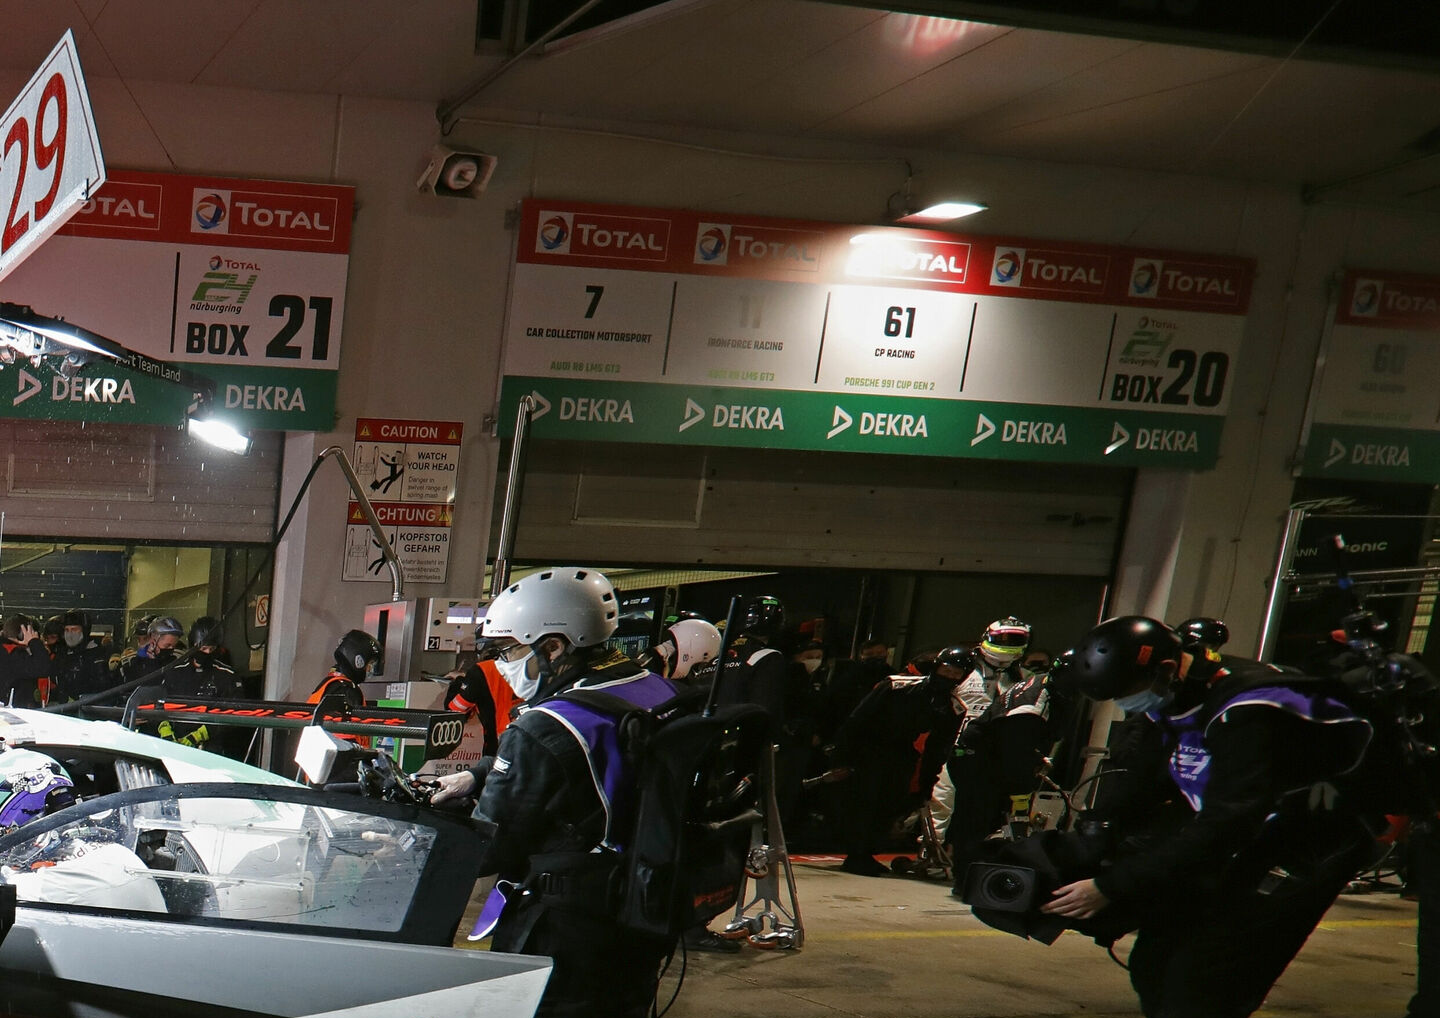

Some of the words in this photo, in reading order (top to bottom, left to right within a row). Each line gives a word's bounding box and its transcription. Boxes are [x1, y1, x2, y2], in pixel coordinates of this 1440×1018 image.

[1, 72, 68, 257] 29
[78, 197, 155, 219] OTAL
[900, 252, 962, 273] OTAL
[190, 302, 242, 315] nürburgring
[584, 285, 604, 318] 7
[265, 294, 333, 360] 21
[884, 306, 916, 338] 61
[185, 322, 250, 357] BOX
[526, 327, 544, 338] CAR
[545, 329, 595, 340] COLLECTION
[597, 331, 652, 343] MOTORSPORT
[753, 340, 783, 351] RACING
[875, 348, 885, 357] CP
[887, 349, 915, 359] RACING
[137, 354, 160, 375] Team
[161, 364, 181, 382] Land
[550, 361, 571, 371] AUDI
[585, 363, 603, 373] LMS
[1161, 349, 1230, 407] 20
[52, 376, 136, 404] DEKRA
[845, 377, 880, 388] PORSCHE
[881, 379, 895, 388] 991
[896, 380, 912, 389] CUP
[913, 381, 928, 390] GEN
[930, 382, 936, 391] 2
[1110, 373, 1163, 403] BOX
[225, 384, 306, 411] DEKRA
[560, 396, 634, 424] DEKRA
[713, 404, 785, 431] DEKRA
[381, 425, 438, 439] CAUTION
[860, 411, 928, 438] DEKRA
[1002, 420, 1068, 445] DEKRA
[1135, 429, 1199, 453] DEKRA
[408, 462, 430, 470] YOUR
[418, 452, 447, 460] WATCH
[1351, 445, 1410, 467] DEKRA
[377, 507, 436, 521] CHTUNG
[400, 533, 448, 542] KOPFSTOß
[404, 544, 441, 553] GEFAHR
[429, 637, 440, 649] 21
